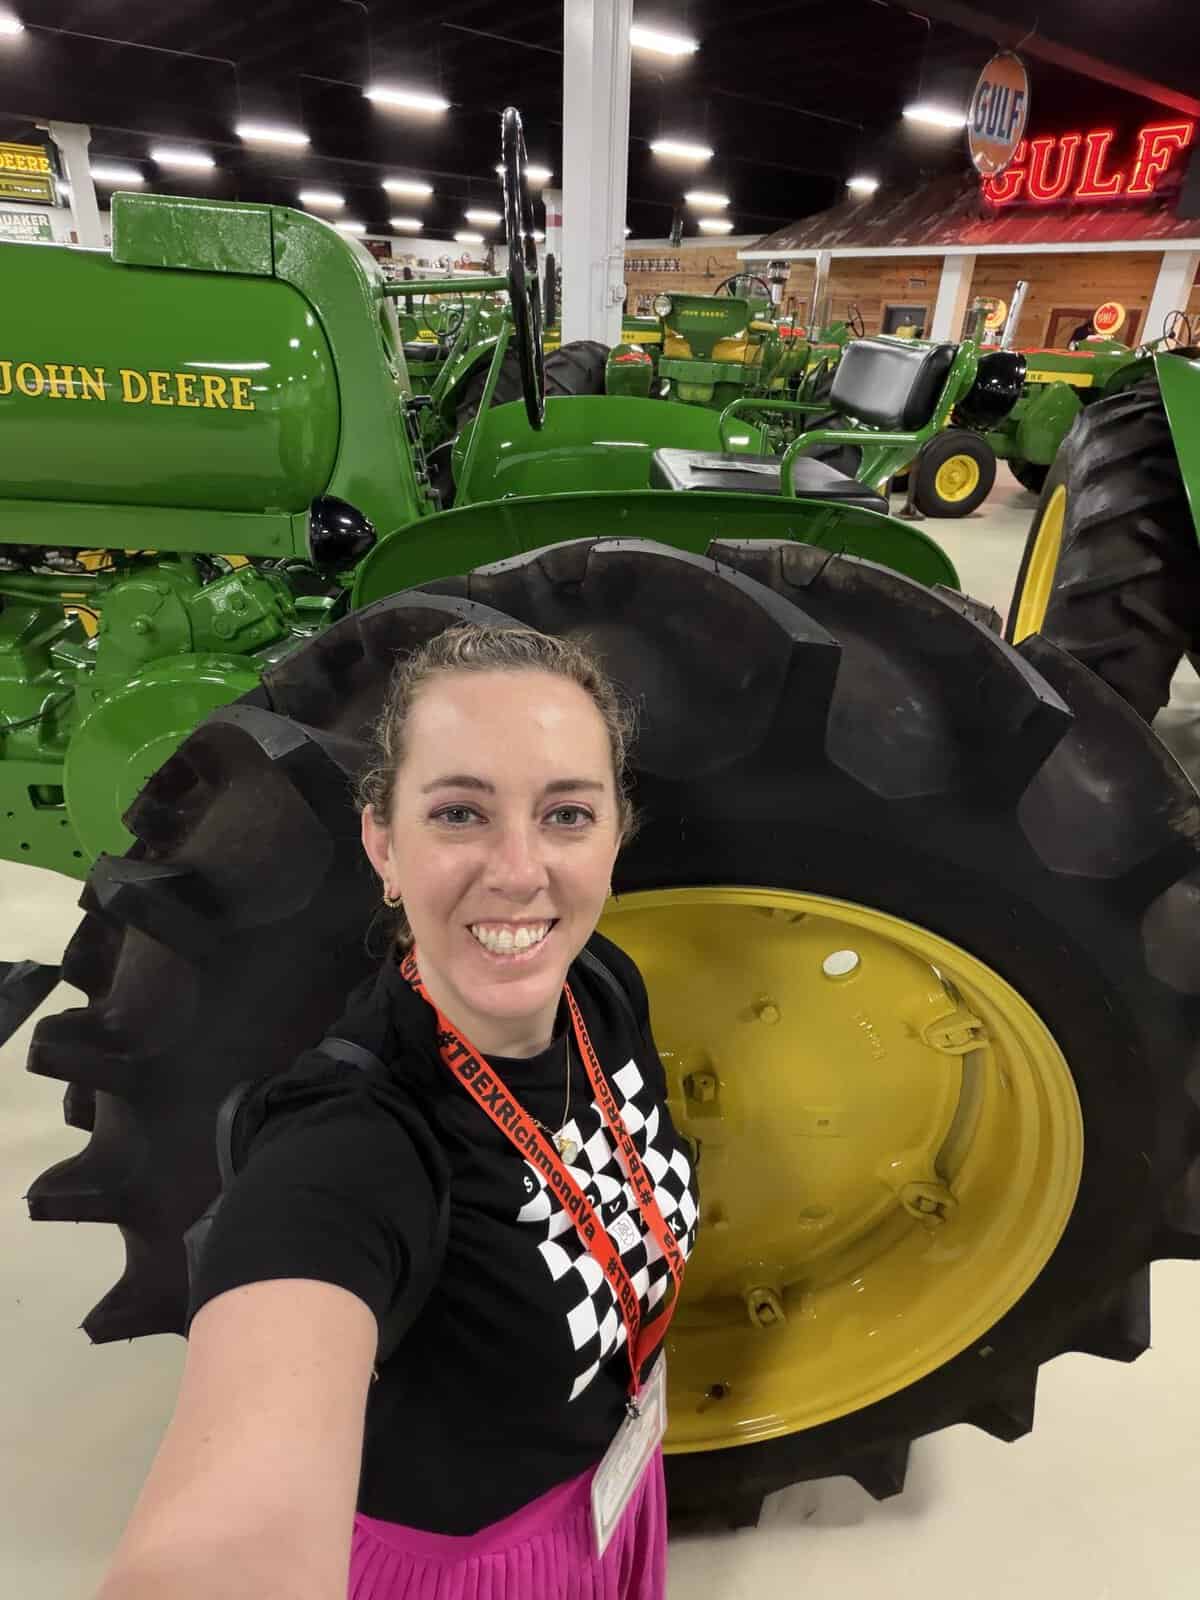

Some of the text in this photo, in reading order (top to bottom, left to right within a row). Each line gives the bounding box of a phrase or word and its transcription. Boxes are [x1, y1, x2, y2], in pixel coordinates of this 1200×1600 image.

[973, 80, 1025, 140] GULF
[982, 122, 1194, 203] GULF
[0, 213, 50, 226] UAKER
[0, 361, 256, 411] JOHN DEERE
[438, 1030, 597, 1242] #TBEXRichmondVa
